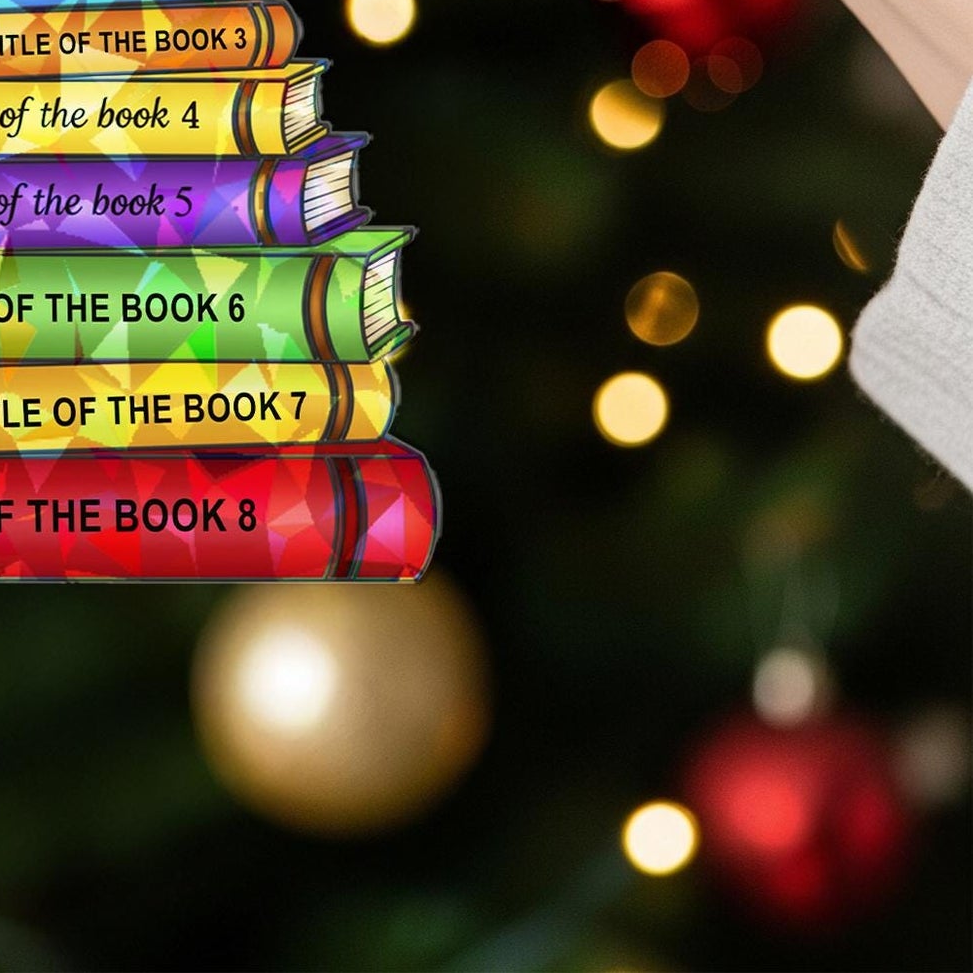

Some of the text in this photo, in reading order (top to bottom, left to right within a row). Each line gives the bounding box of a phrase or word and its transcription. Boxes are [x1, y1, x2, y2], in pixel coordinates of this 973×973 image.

[59, 32, 91, 55] OF
[98, 30, 147, 53] THE
[155, 28, 228, 52] BOOK
[235, 27, 247, 50] 3
[0, 96, 36, 138] of
[40, 96, 88, 129] the
[97, 96, 170, 129] book
[181, 101, 200, 129] 4
[33, 183, 81, 216] the
[92, 183, 165, 216] book
[175, 186, 192, 217] 5
[44, 293, 110, 323] THE
[121, 292, 219, 323] BOOK
[228, 293, 245, 323] 6
[53, 396, 96, 427] OF
[107, 394, 172, 425] THE
[184, 391, 282, 423] BOOK
[290, 391, 307, 420] 7
[26, 498, 101, 533] THE
[115, 498, 226, 533] BOOK
[238, 498, 257, 532] 8
